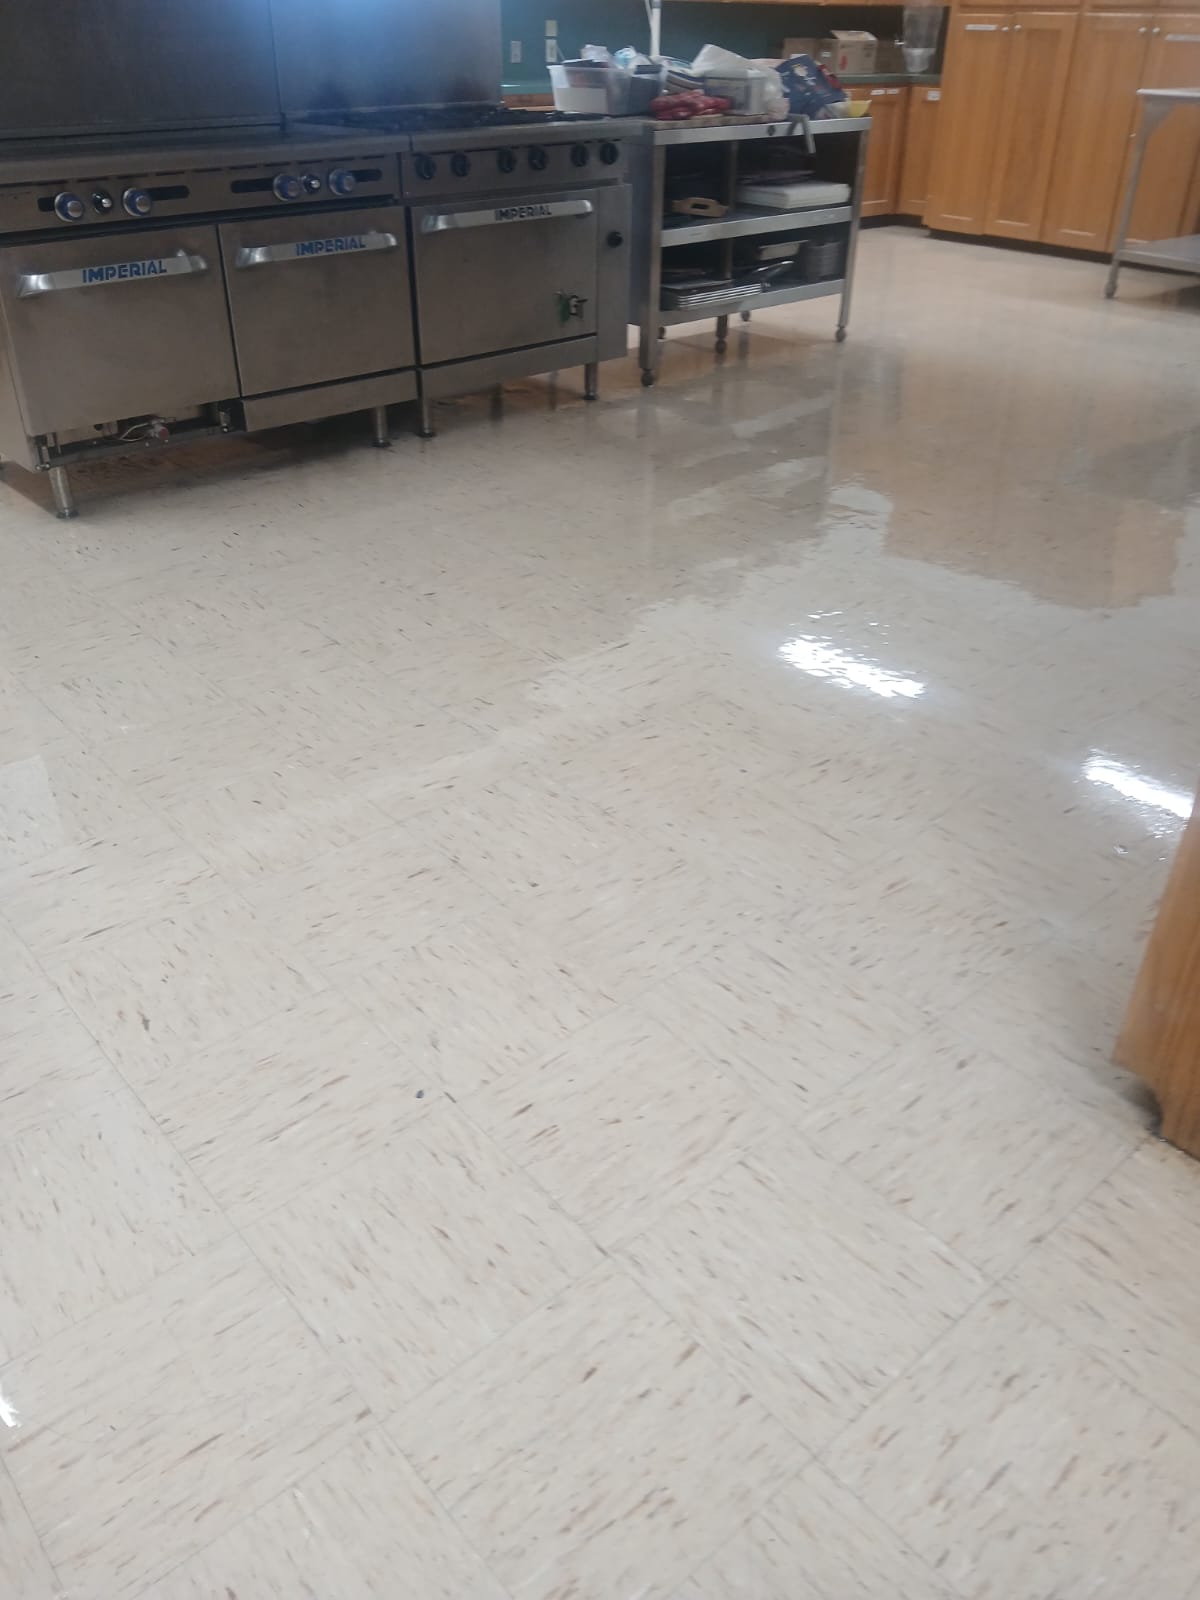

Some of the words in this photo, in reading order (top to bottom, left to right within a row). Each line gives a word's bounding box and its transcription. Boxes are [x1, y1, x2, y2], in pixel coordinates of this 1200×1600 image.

[495, 205, 552, 221] IMPERIAL
[296, 236, 366, 256] IMPERIAL
[82, 260, 167, 283] IMPERIAL
